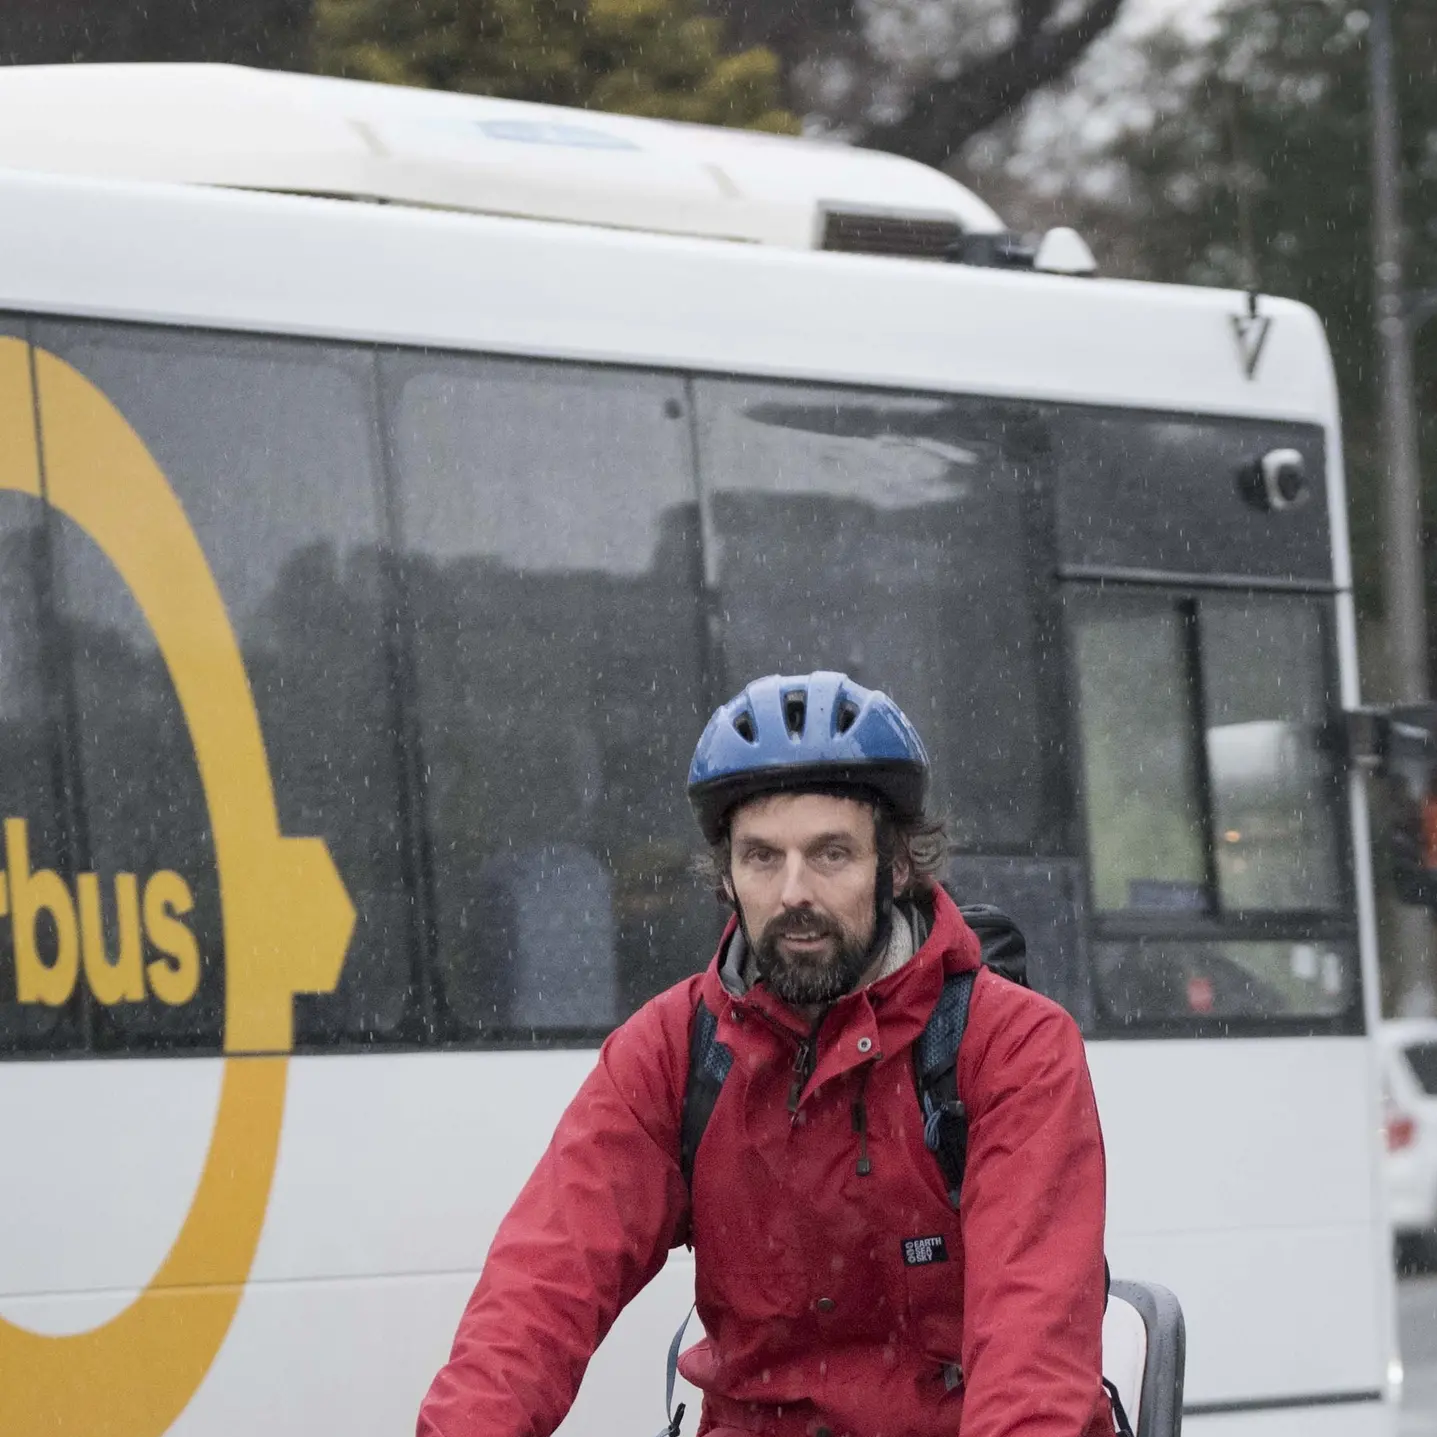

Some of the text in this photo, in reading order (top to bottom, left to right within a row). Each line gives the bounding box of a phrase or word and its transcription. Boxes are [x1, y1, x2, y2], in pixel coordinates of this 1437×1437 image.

[0, 817, 200, 1006] bus
[914, 1237, 942, 1247] EARTH
[915, 1246, 933, 1255] SEA
[916, 1254, 933, 1262] SKY
